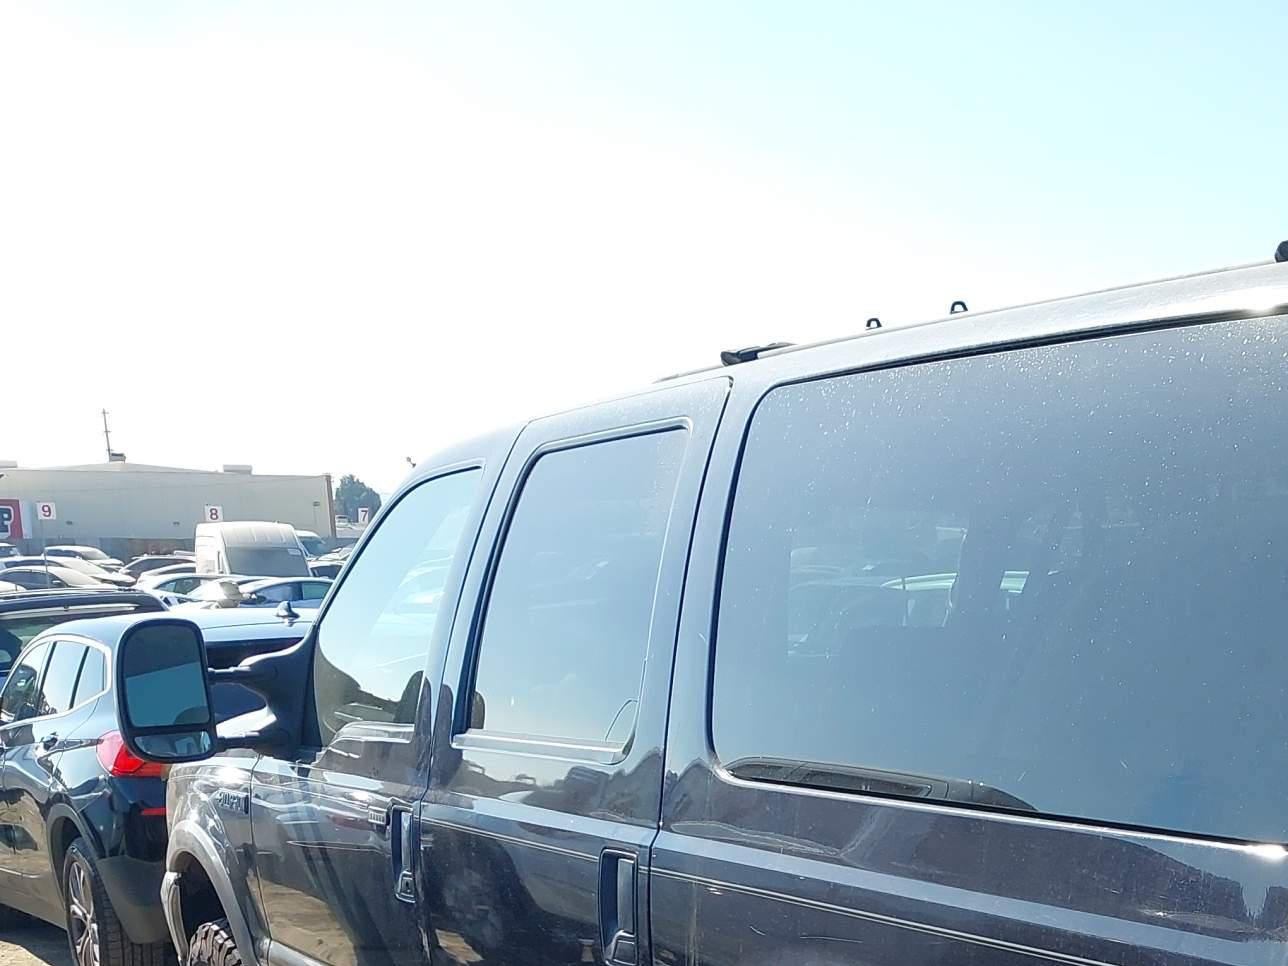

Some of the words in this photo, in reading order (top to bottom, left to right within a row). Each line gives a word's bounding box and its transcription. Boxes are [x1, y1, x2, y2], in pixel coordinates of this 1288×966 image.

[41, 504, 52, 518] 9
[209, 507, 219, 521] 8
[360, 509, 368, 522] 7
